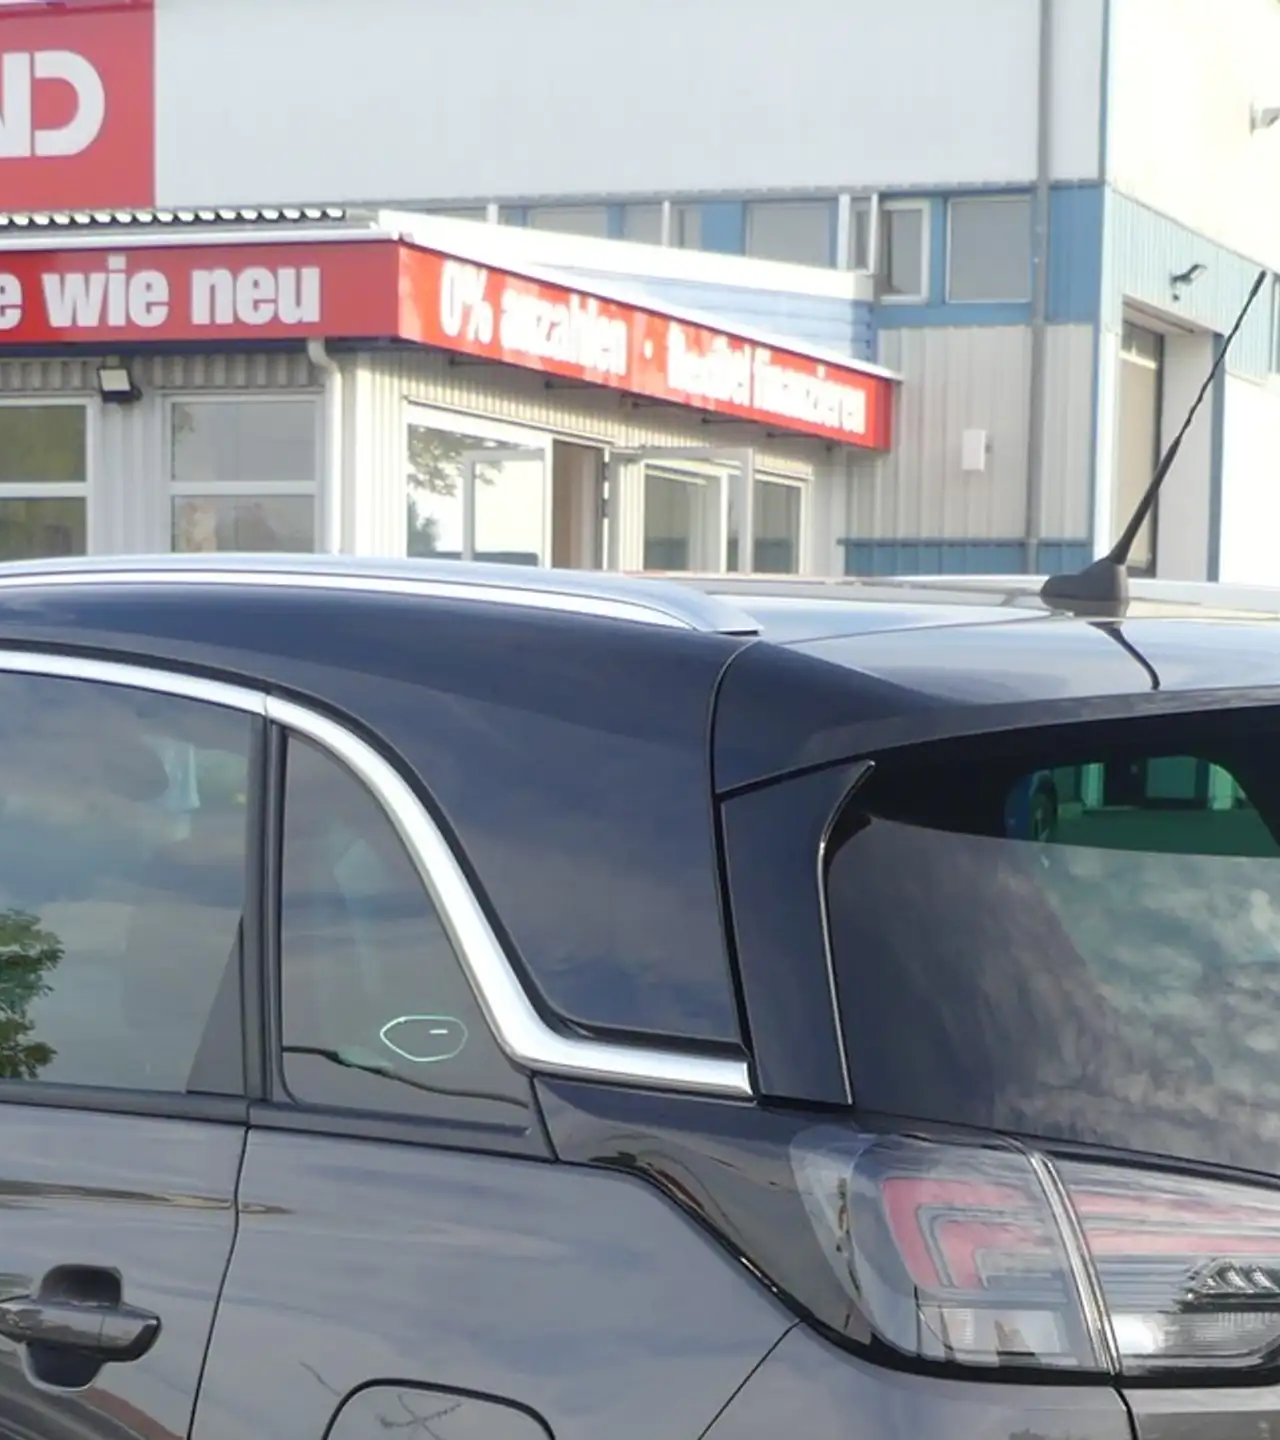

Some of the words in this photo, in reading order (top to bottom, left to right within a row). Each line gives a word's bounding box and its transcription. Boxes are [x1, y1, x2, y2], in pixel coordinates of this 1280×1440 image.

[43, 256, 169, 328] wie
[190, 266, 321, 326] neu
[440, 259, 494, 345] 0%
